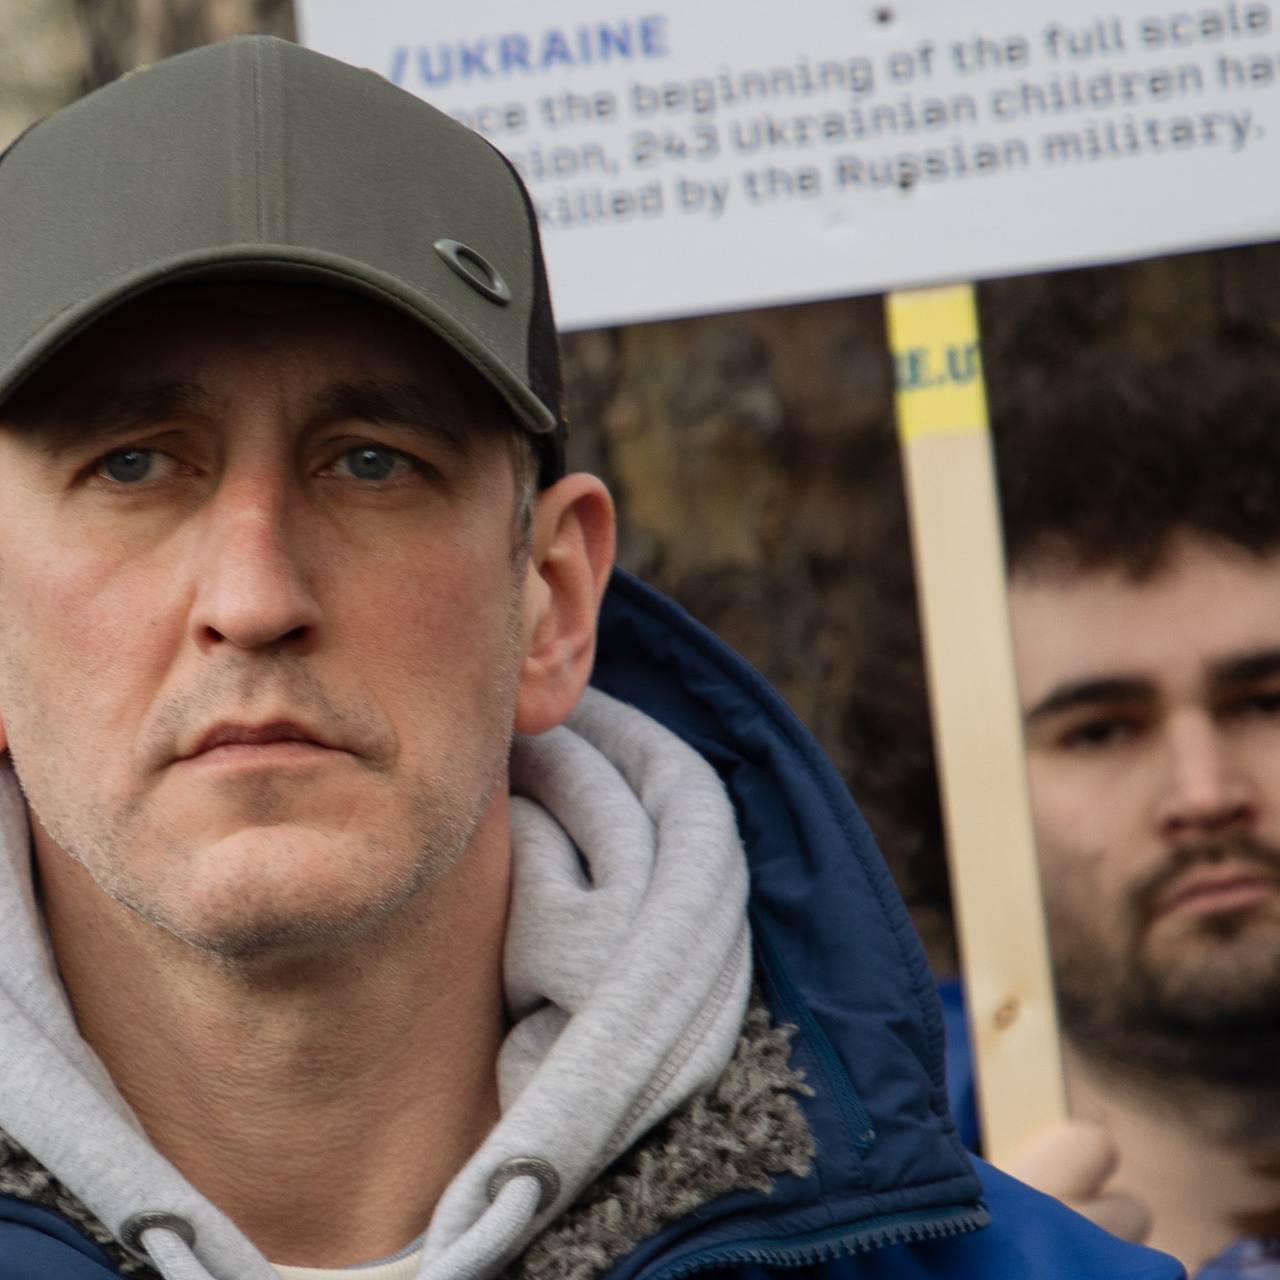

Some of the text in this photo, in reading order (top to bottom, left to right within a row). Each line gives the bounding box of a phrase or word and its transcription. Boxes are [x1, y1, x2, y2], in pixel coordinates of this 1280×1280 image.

[390, 16, 669, 85] /UKRAINE
[540, 93, 616, 128] the
[632, 56, 872, 114] beginning
[889, 42, 933, 81] of
[952, 35, 1028, 71] the
[1046, 17, 1125, 59] full
[1141, 1, 1271, 48] scale
[631, 123, 719, 167] 243
[734, 96, 976, 152] Ukrainian
[991, 66, 1202, 118] children
[679, 176, 728, 218] by
[745, 168, 819, 203] the
[837, 137, 1027, 188] Russian
[1044, 111, 1263, 163] military.
